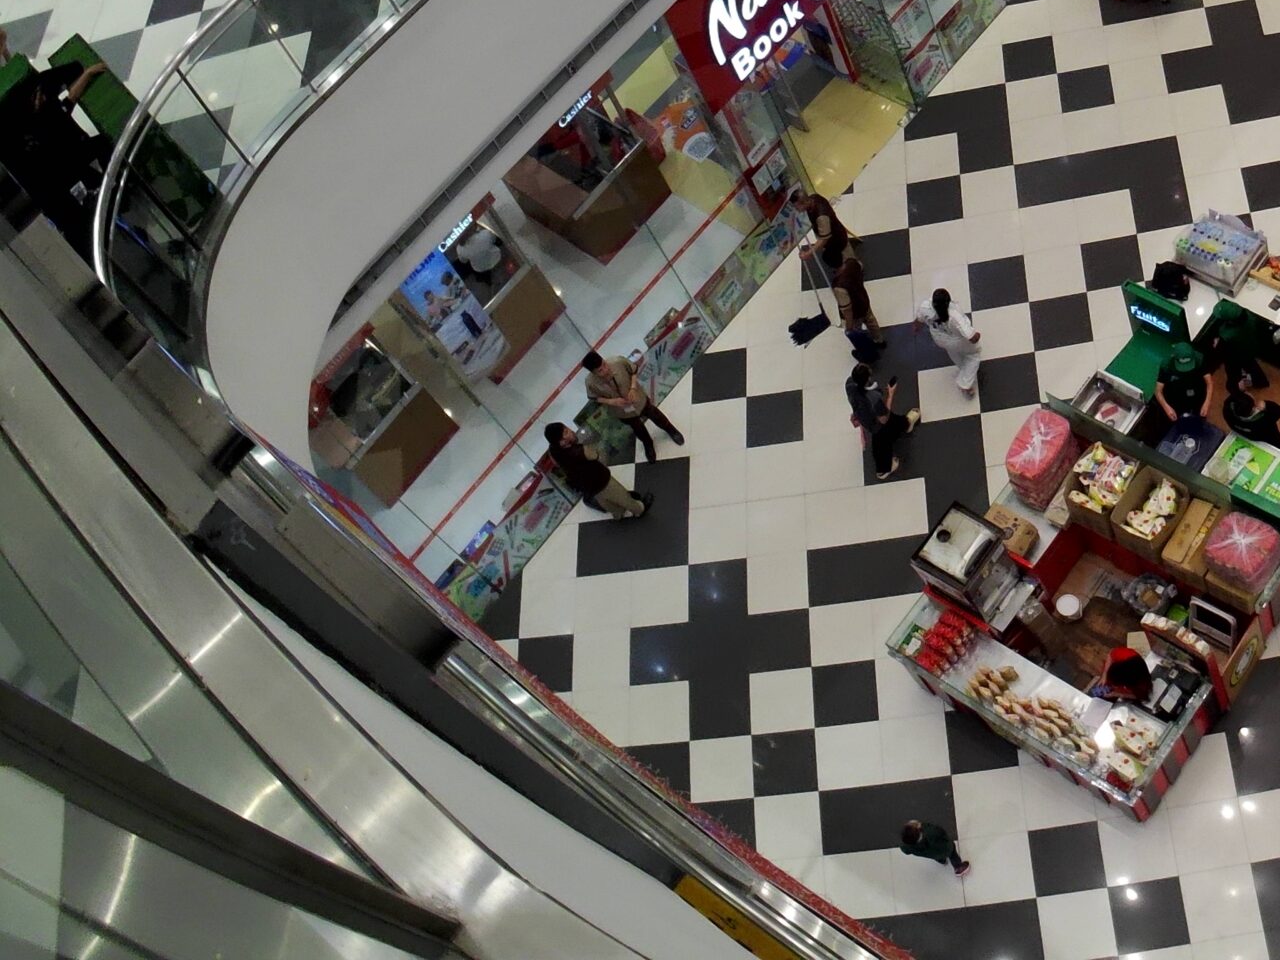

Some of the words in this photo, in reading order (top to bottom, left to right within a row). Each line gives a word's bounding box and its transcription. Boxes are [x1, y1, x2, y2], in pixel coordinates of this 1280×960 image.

[730, 0, 805, 81] Book
[558, 90, 593, 128] Cashier
[438, 213, 474, 253] Cashier
